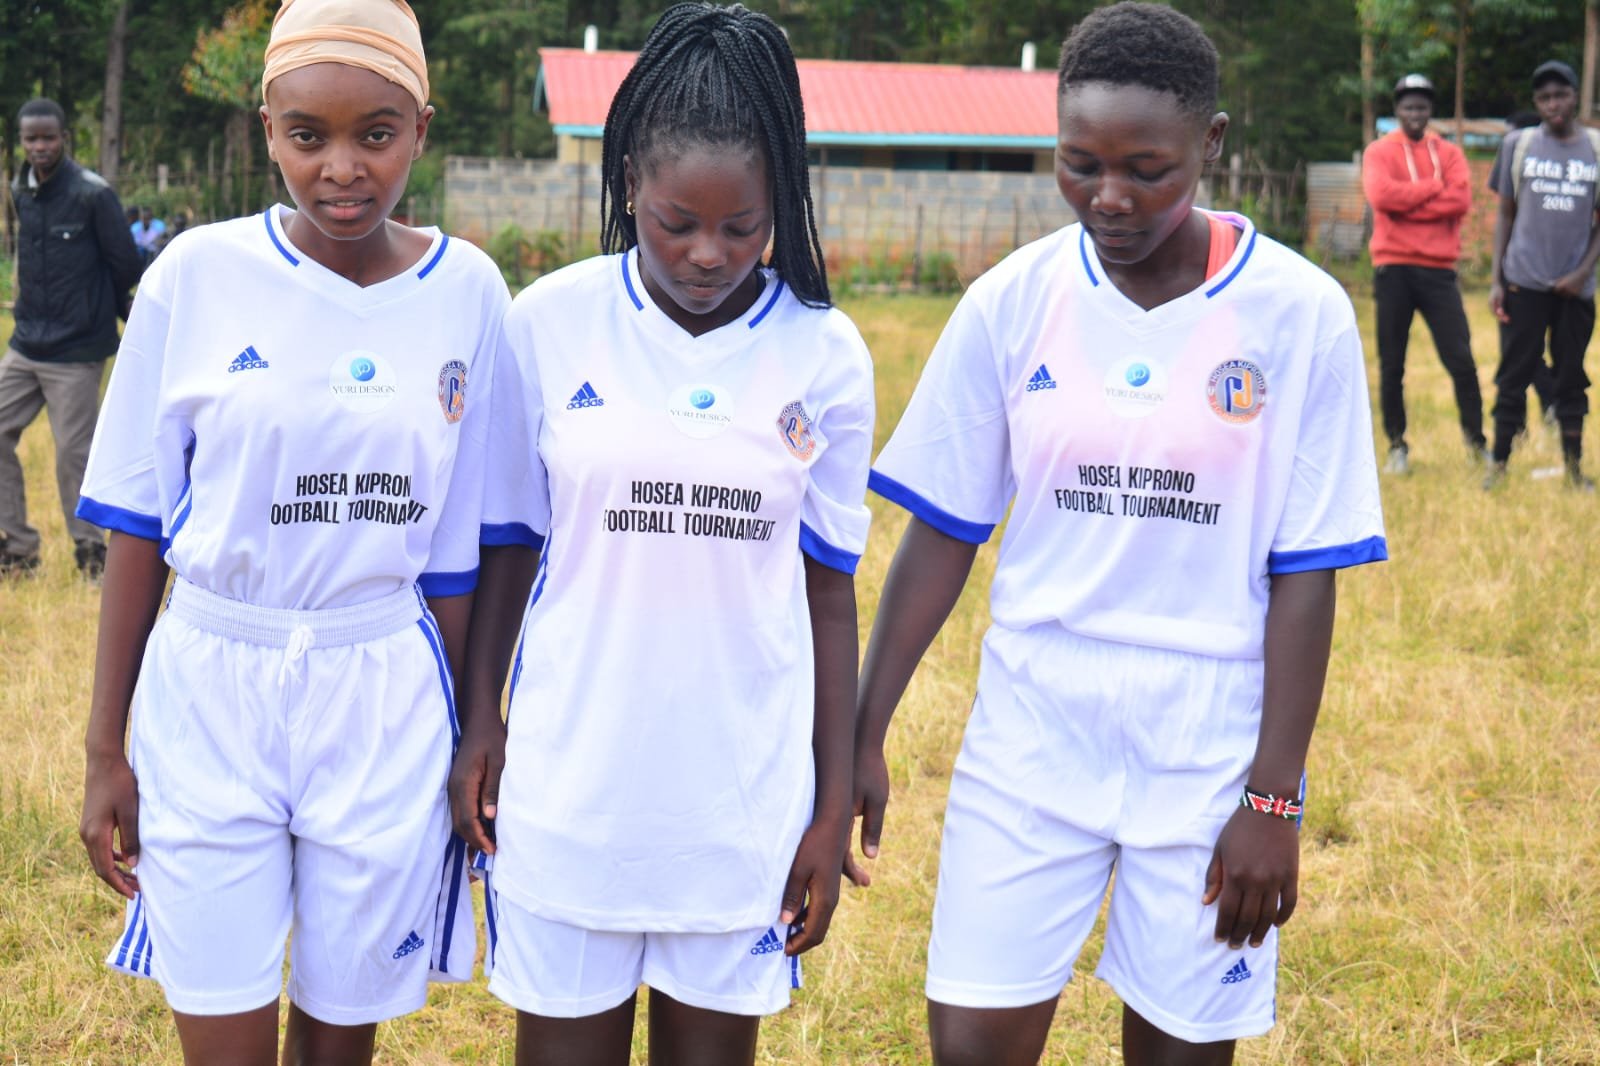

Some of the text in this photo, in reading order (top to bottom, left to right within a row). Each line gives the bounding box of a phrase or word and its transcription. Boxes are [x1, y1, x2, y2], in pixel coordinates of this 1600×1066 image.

[1523, 156, 1563, 179] Zeta
[228, 360, 270, 374] adidas
[332, 384, 396, 395] YURI DESIGN
[1026, 380, 1057, 393] adidas
[566, 398, 605, 411] adidas
[695, 411, 732, 423] DESIGN
[296, 472, 412, 498] HOSEA KIPRON
[1078, 464, 1195, 494] HOSEA KIPRONO
[631, 480, 762, 513] HOSEA KIPRONO
[1054, 489, 1222, 526] FOOTBALL TOURNAMENT
[271, 500, 340, 526] OOTBALL
[684, 512, 776, 542] TOURNAMENT
[392, 938, 425, 960] adidas
[750, 941, 784, 956] adidas
[1221, 969, 1252, 984] adidas
